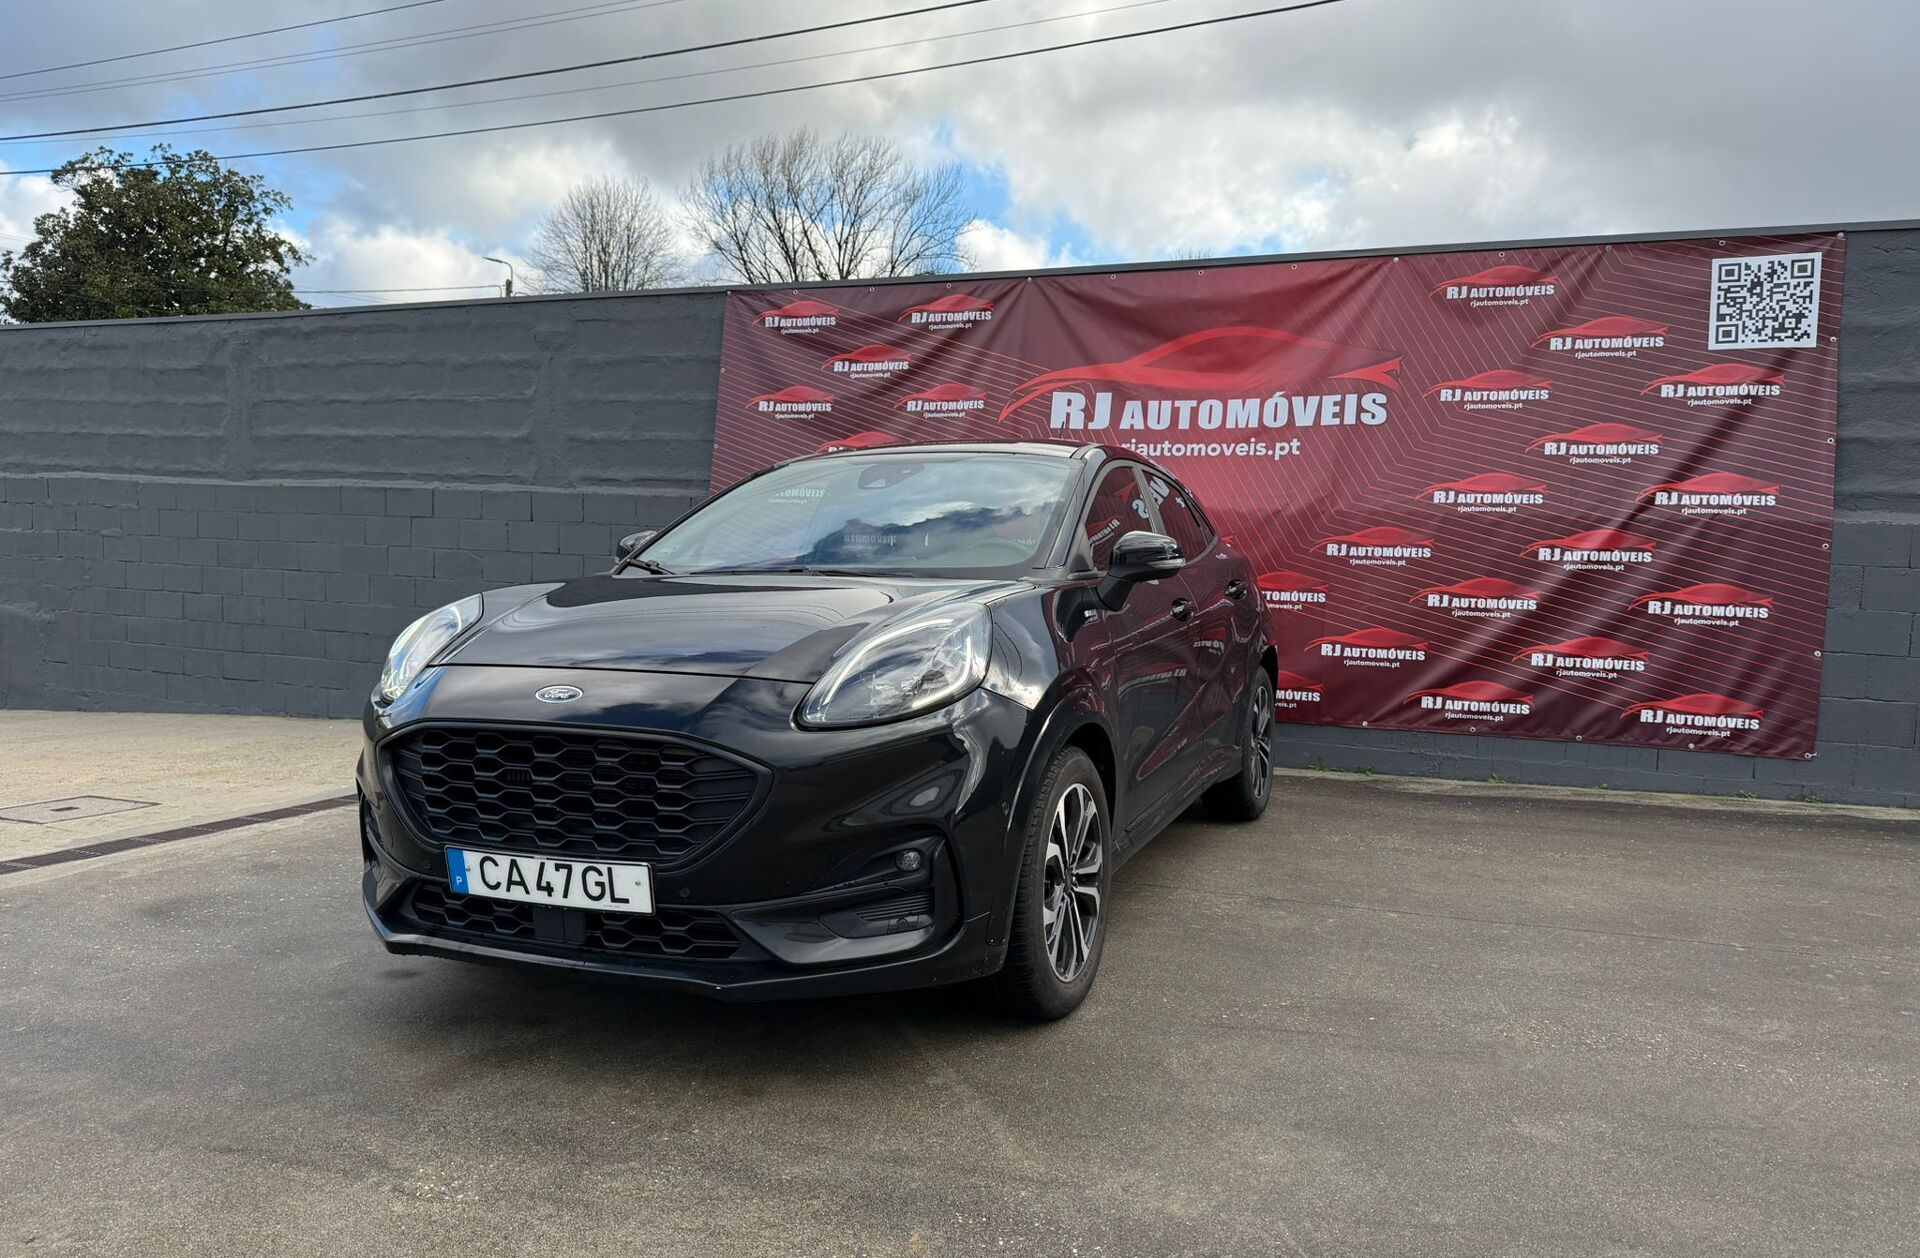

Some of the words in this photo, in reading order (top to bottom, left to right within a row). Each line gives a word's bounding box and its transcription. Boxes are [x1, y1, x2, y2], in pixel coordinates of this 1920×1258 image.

[1446, 285, 1467, 299] RJ
[1470, 284, 1555, 298] AUTOMÓVEIS
[1470, 299, 1529, 307] rjautomoveis.pt
[765, 317, 778, 327] RJ
[780, 316, 836, 326] AUTOMÓVEIS
[911, 312, 927, 323] RJ
[928, 311, 992, 322] AUTOMÓVEIS
[1550, 337, 1572, 350] RJ
[1575, 336, 1664, 349] AUTOMÓVEIS
[1575, 350, 1637, 358] rjautomoveis.pt
[834, 361, 849, 372] RJ
[850, 360, 909, 371] AUTOMÓVEIS
[1440, 389, 1461, 401] RJ
[1464, 387, 1549, 401] AUTOMÓVEIS
[1661, 384, 1685, 397] RJ
[1687, 383, 1781, 396] AUTOMÓVEIS
[759, 401, 773, 412] RJ
[775, 401, 832, 412] AUTOMÓVEIS
[906, 400, 922, 411] RJ
[923, 400, 984, 410] AUTOMÓVEIS
[1464, 402, 1523, 410] rjautomoveis.pt
[1687, 397, 1752, 406] rjautomoveis.pt
[1050, 392, 1113, 430] RJ
[1119, 391, 1388, 430] AUTOMÓVEIS
[1544, 442, 1567, 455] RJ
[1569, 442, 1659, 455] AUTOMÓVEIS
[1569, 456, 1631, 464] rjautomoveis.pt
[1433, 491, 1454, 503] RJ
[1456, 491, 1543, 504] AUTOMÓVEIS
[1655, 492, 1678, 505] RJ
[1681, 493, 1776, 506] AUTOMÓVEIS
[1457, 505, 1517, 513] rjautomoveis.pt
[1681, 507, 1747, 515] rjautomoveis.pt
[1327, 544, 1347, 557] RJ
[1349, 546, 1431, 558] AUTOMÓVEIS
[1538, 548, 1561, 561] RJ
[1563, 549, 1653, 563] AUTOMÓVEIS
[1563, 563, 1624, 571] rjautomoveis.pt
[1262, 591, 1326, 603] TOMÓVEIS
[1428, 594, 1450, 607] RJ
[1451, 597, 1537, 611] AUTOMÓVEIS
[1452, 610, 1511, 618] rjautomoveis.pt
[1648, 601, 1671, 615] RJ
[1674, 604, 1769, 618] AUTOMÓVEIS
[1674, 617, 1739, 627] rjautomoveis.pt
[1321, 644, 1341, 656] RJ
[1344, 648, 1425, 661] AUTOMÓVEIS
[1344, 660, 1400, 668] rjautomoveis.pt
[1531, 654, 1553, 667] RJ
[1556, 656, 1645, 671] AUTOMÓVEIS
[1556, 669, 1617, 679] rjautomoveis.pt
[540, 688, 579, 700] Ford
[1275, 690, 1320, 702] MÓVEIS
[1421, 696, 1443, 709] RJ
[1445, 699, 1530, 715] AUTOMÓVEIS
[1445, 712, 1504, 722] rjautomoveis.pt
[1640, 710, 1664, 724] RJ
[1666, 713, 1760, 730] AUTOMÓVEIS
[1666, 727, 1731, 737] rjautomoveis.pt
[455, 876, 462, 885] P
